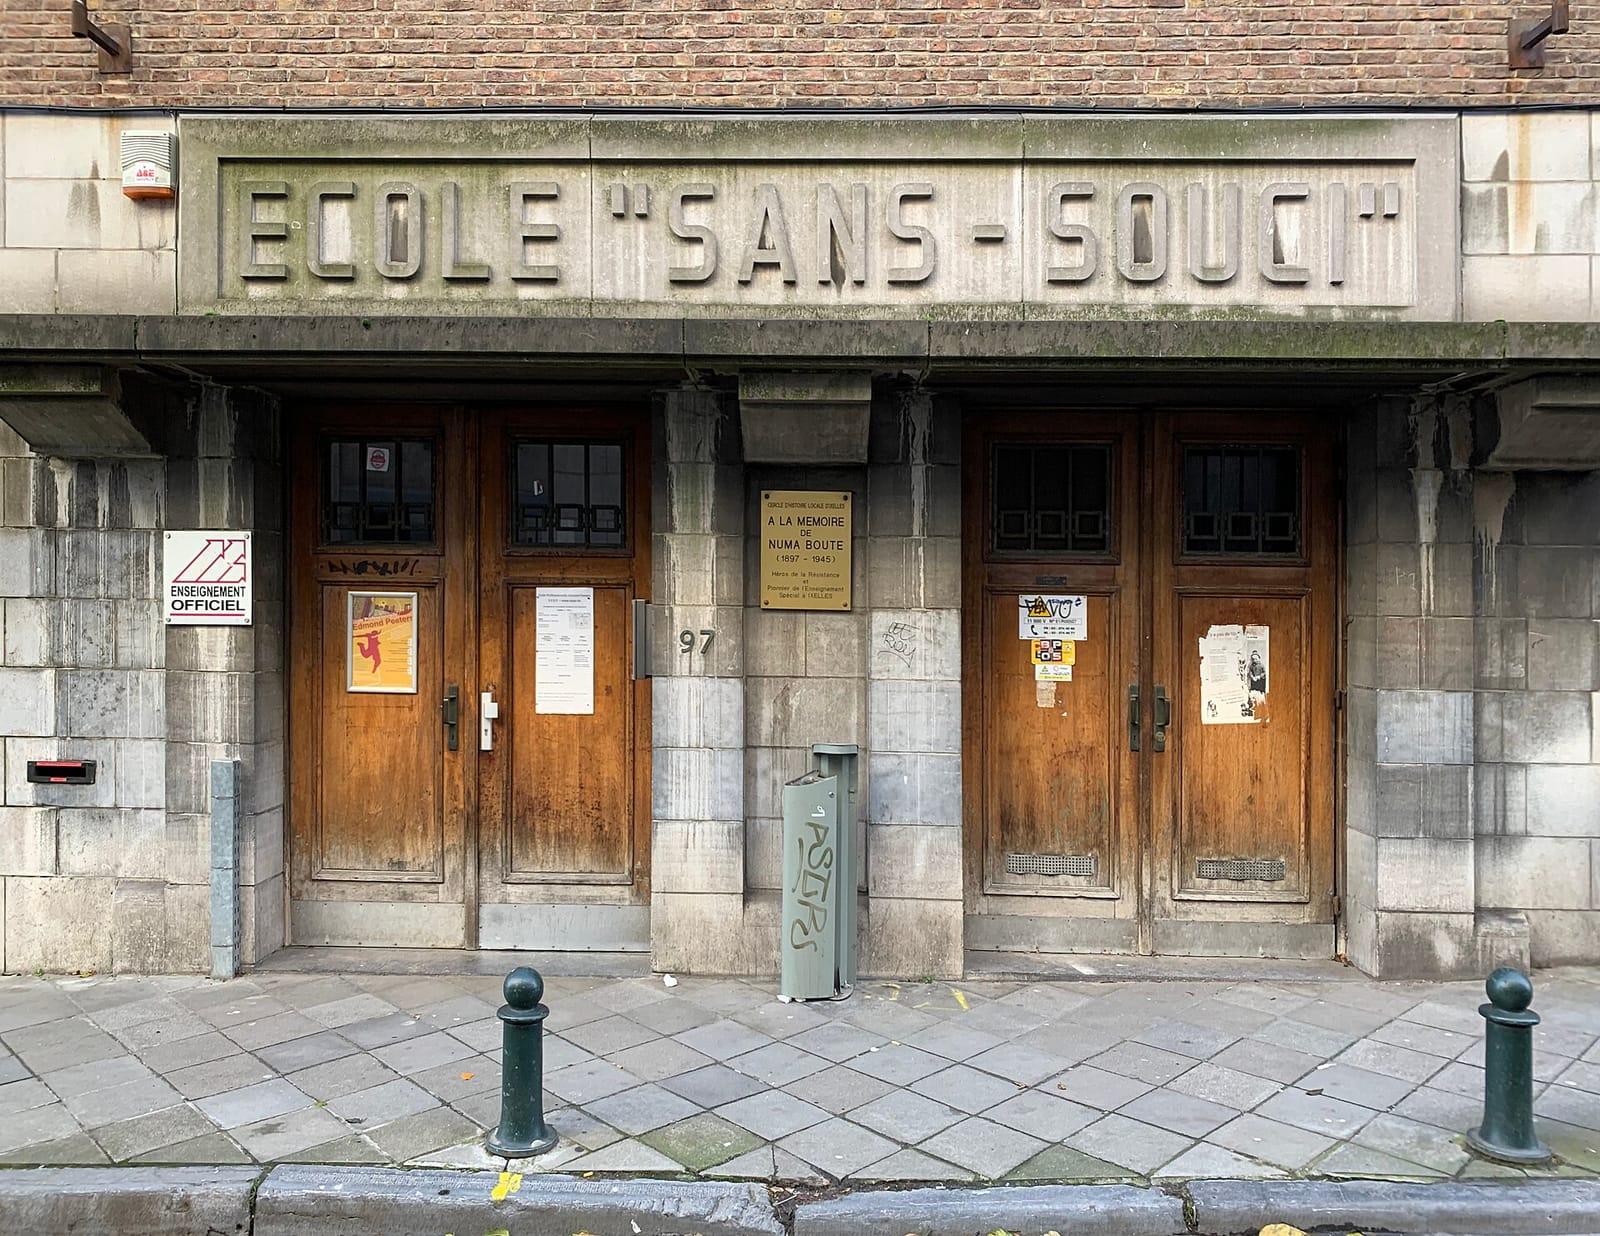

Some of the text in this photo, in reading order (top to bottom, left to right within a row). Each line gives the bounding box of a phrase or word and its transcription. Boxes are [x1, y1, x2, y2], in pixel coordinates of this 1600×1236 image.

[240, 181, 559, 281] ECOLE
[768, 516, 844, 527] A LA MEMOIRE
[768, 540, 844, 550] NUMA BOUTE
[171, 586, 246, 598] ENSEIGNEMENT
[171, 600, 246, 611] OFFICIEL
[352, 621, 384, 630] Edmond
[680, 630, 715, 654] 97
